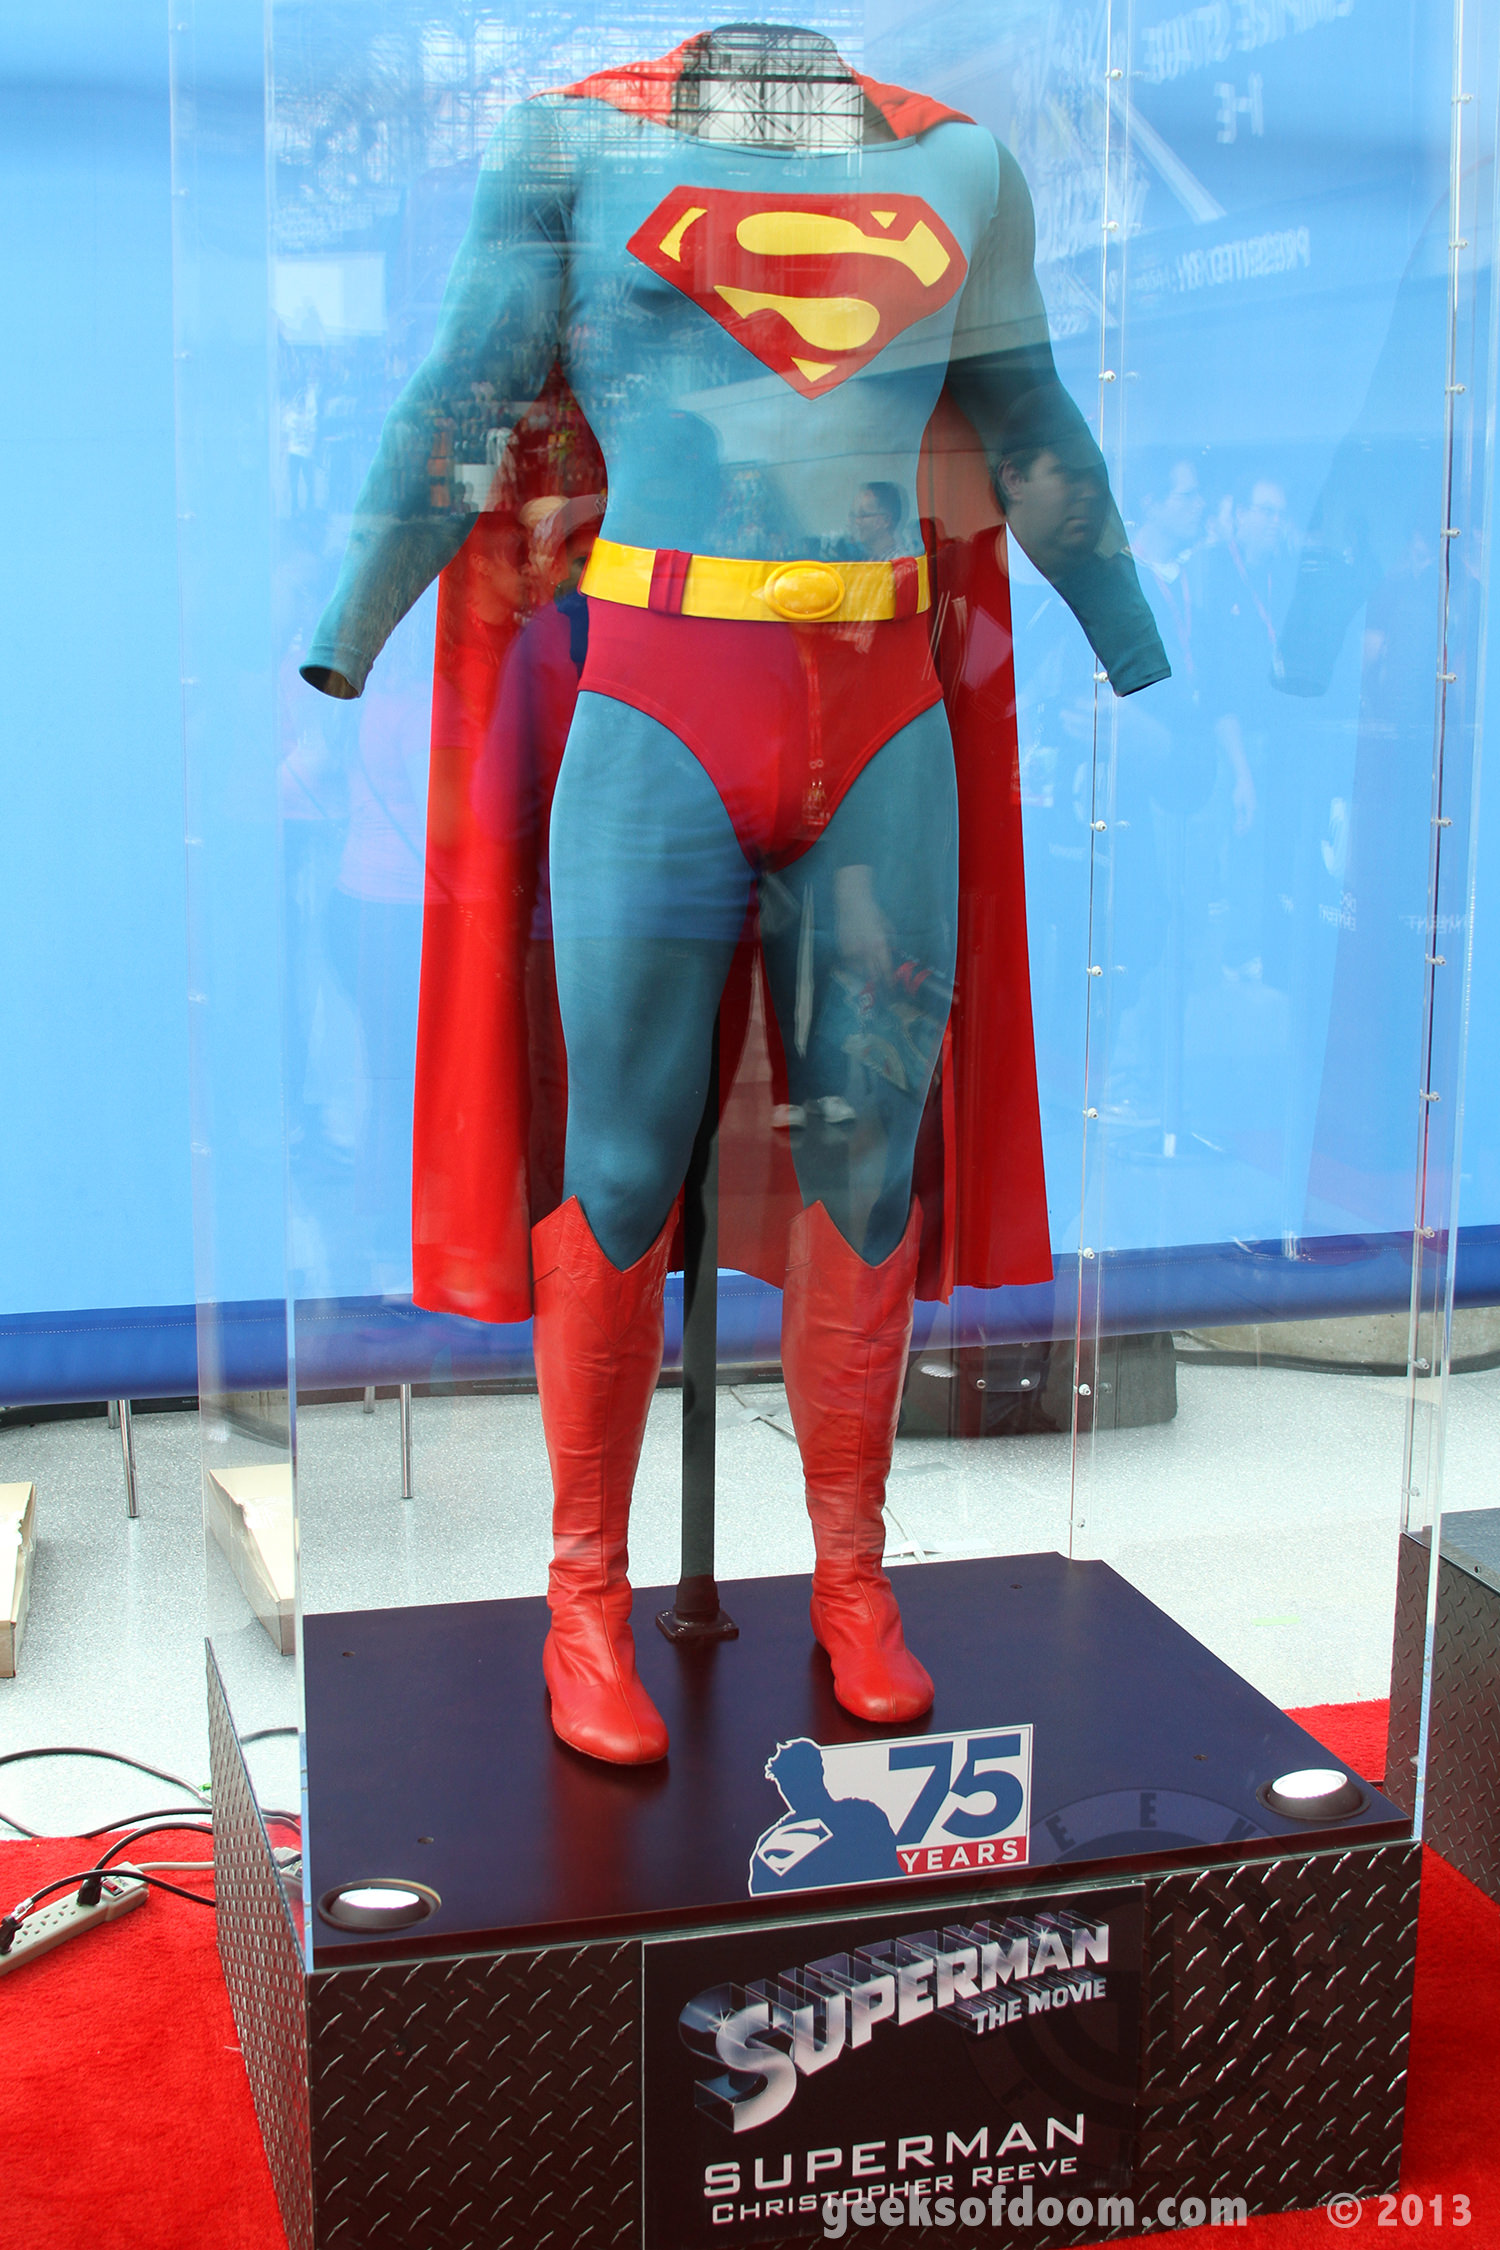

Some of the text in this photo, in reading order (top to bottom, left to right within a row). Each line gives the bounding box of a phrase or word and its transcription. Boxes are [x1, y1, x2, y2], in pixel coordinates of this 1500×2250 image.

[888, 1732, 1024, 1846] 75
[901, 1839, 1018, 1873] YEARS
[684, 1912, 1109, 2133] SUPERMAN
[971, 1978, 1107, 2034] THE MOVIE
[703, 2112, 1084, 2198] SUPERMAN
[711, 2156, 1078, 2225] CHRISTOPHER REEVE
